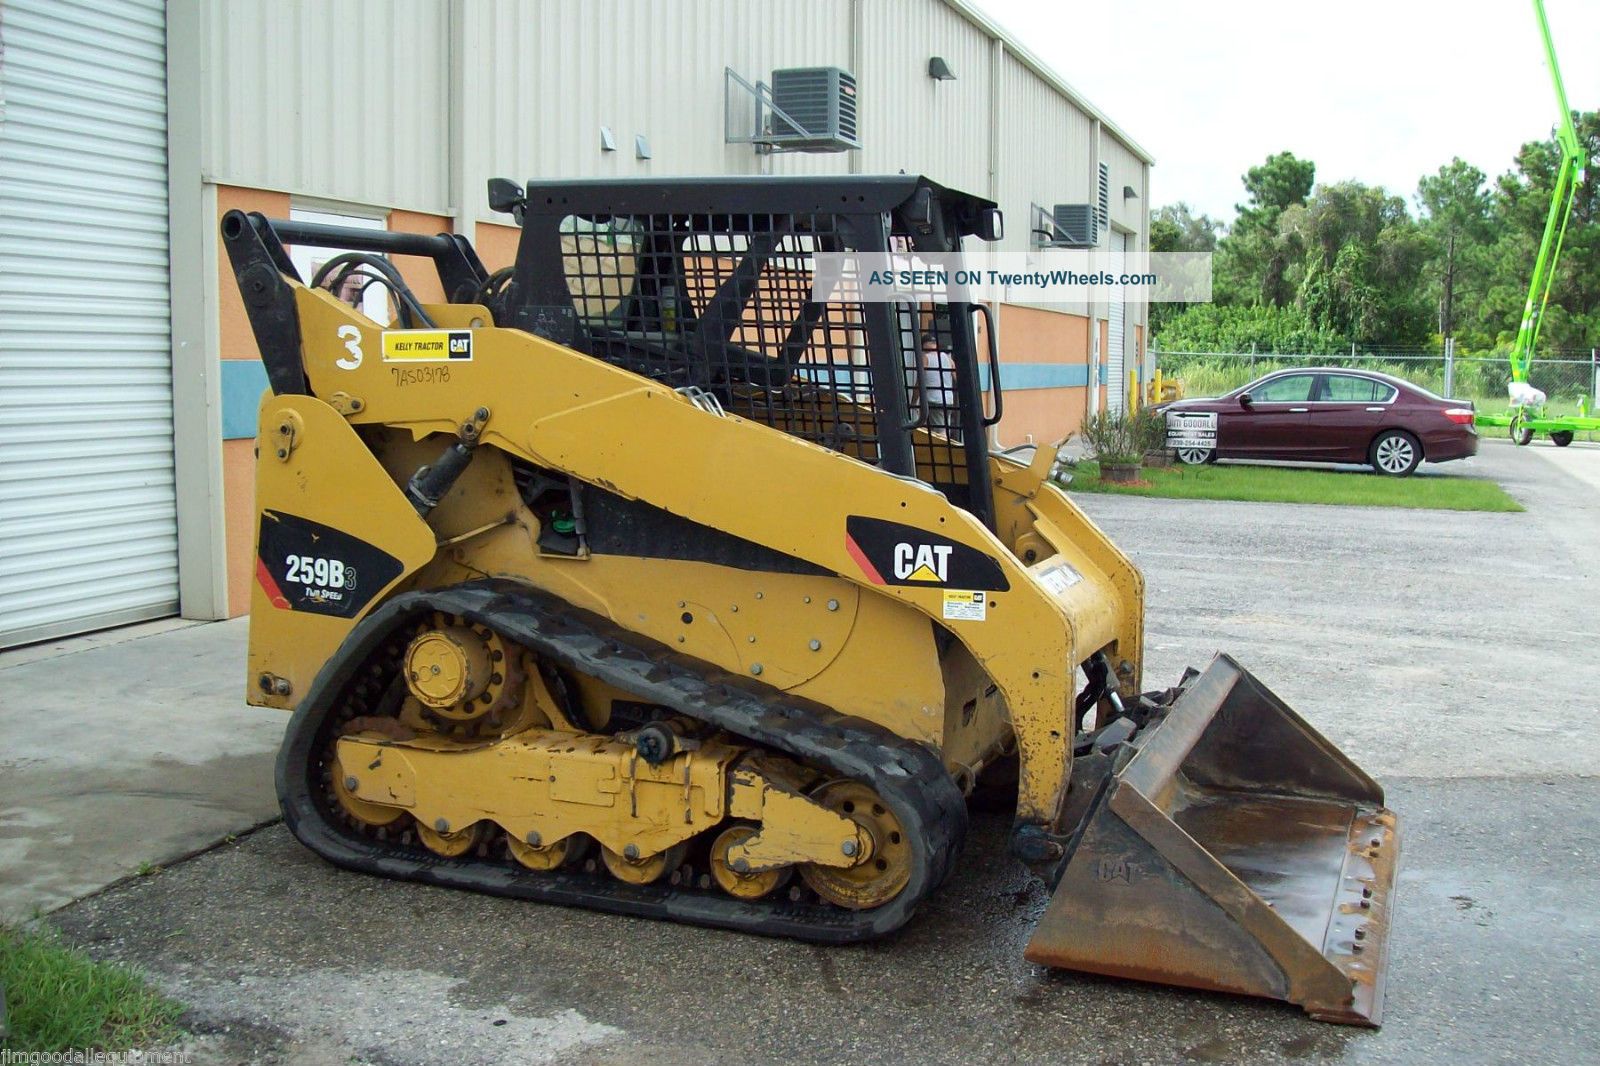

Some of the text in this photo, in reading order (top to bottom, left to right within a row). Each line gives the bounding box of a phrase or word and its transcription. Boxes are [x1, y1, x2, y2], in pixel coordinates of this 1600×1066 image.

[336, 325, 363, 371] 3
[395, 341, 444, 351] KELLY TRACTOR
[450, 339, 469, 353] CAT
[1167, 418, 1182, 428] JIM
[893, 542, 953, 582] CAT
